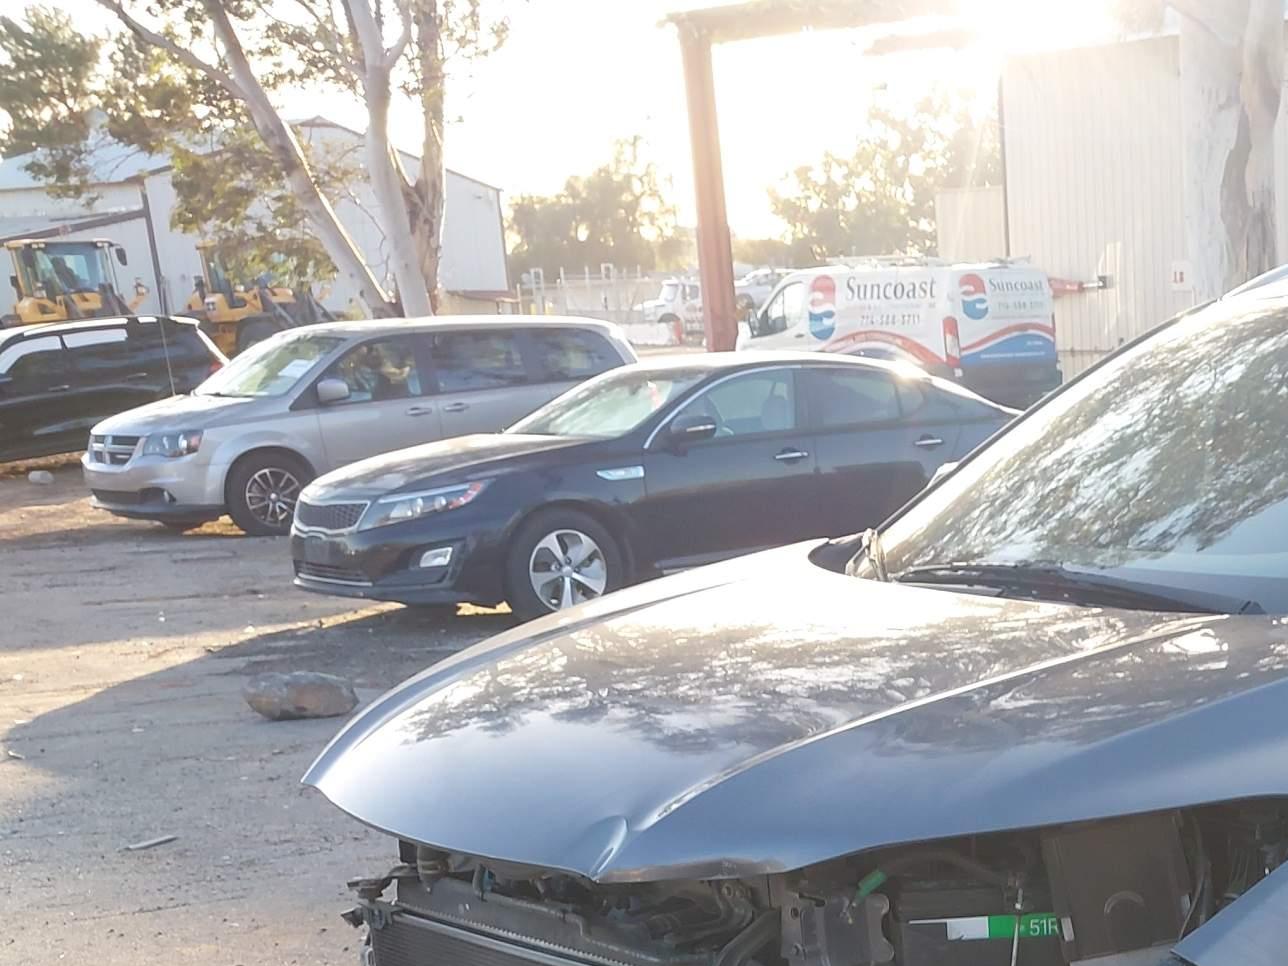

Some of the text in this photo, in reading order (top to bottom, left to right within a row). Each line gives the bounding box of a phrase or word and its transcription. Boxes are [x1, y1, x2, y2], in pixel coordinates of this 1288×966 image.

[845, 276, 937, 301] Suncoast
[988, 277, 1044, 292] Suncoast
[1029, 917, 1059, 937] 51R
